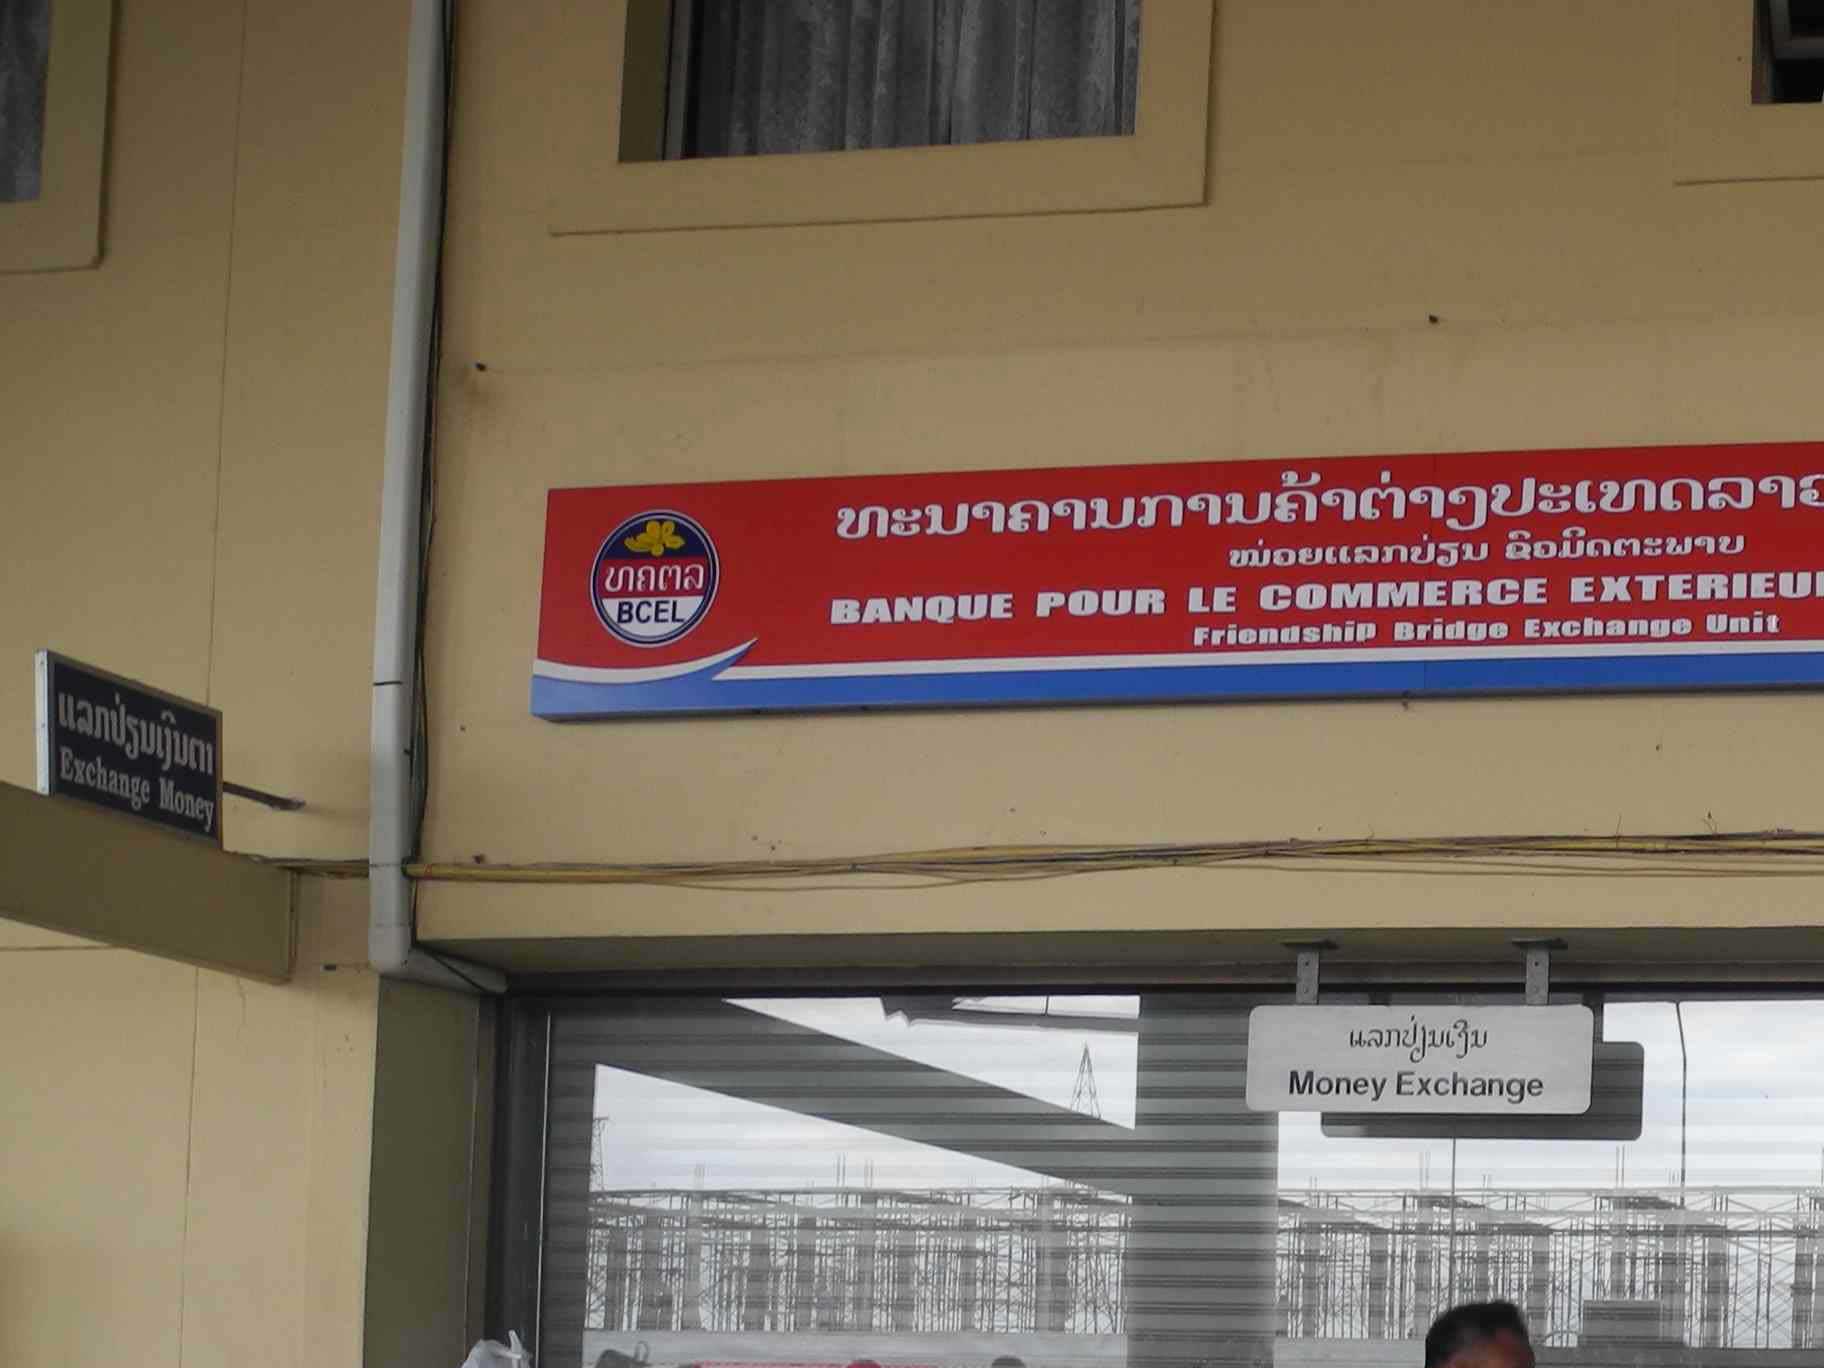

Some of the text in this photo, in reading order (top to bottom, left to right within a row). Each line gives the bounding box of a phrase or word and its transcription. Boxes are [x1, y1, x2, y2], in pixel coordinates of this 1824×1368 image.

[617, 599, 685, 626] BCEL
[830, 593, 1014, 625] BANQUE
[1035, 588, 1166, 617] POUR
[1188, 586, 1236, 613] LE
[1260, 575, 1548, 609] COMMERCE
[1190, 610, 1780, 646] Friendship Bridge Exchange Unit
[59, 746, 214, 832] Exchange Money
[1288, 1071, 1543, 1104] Money Exchange
